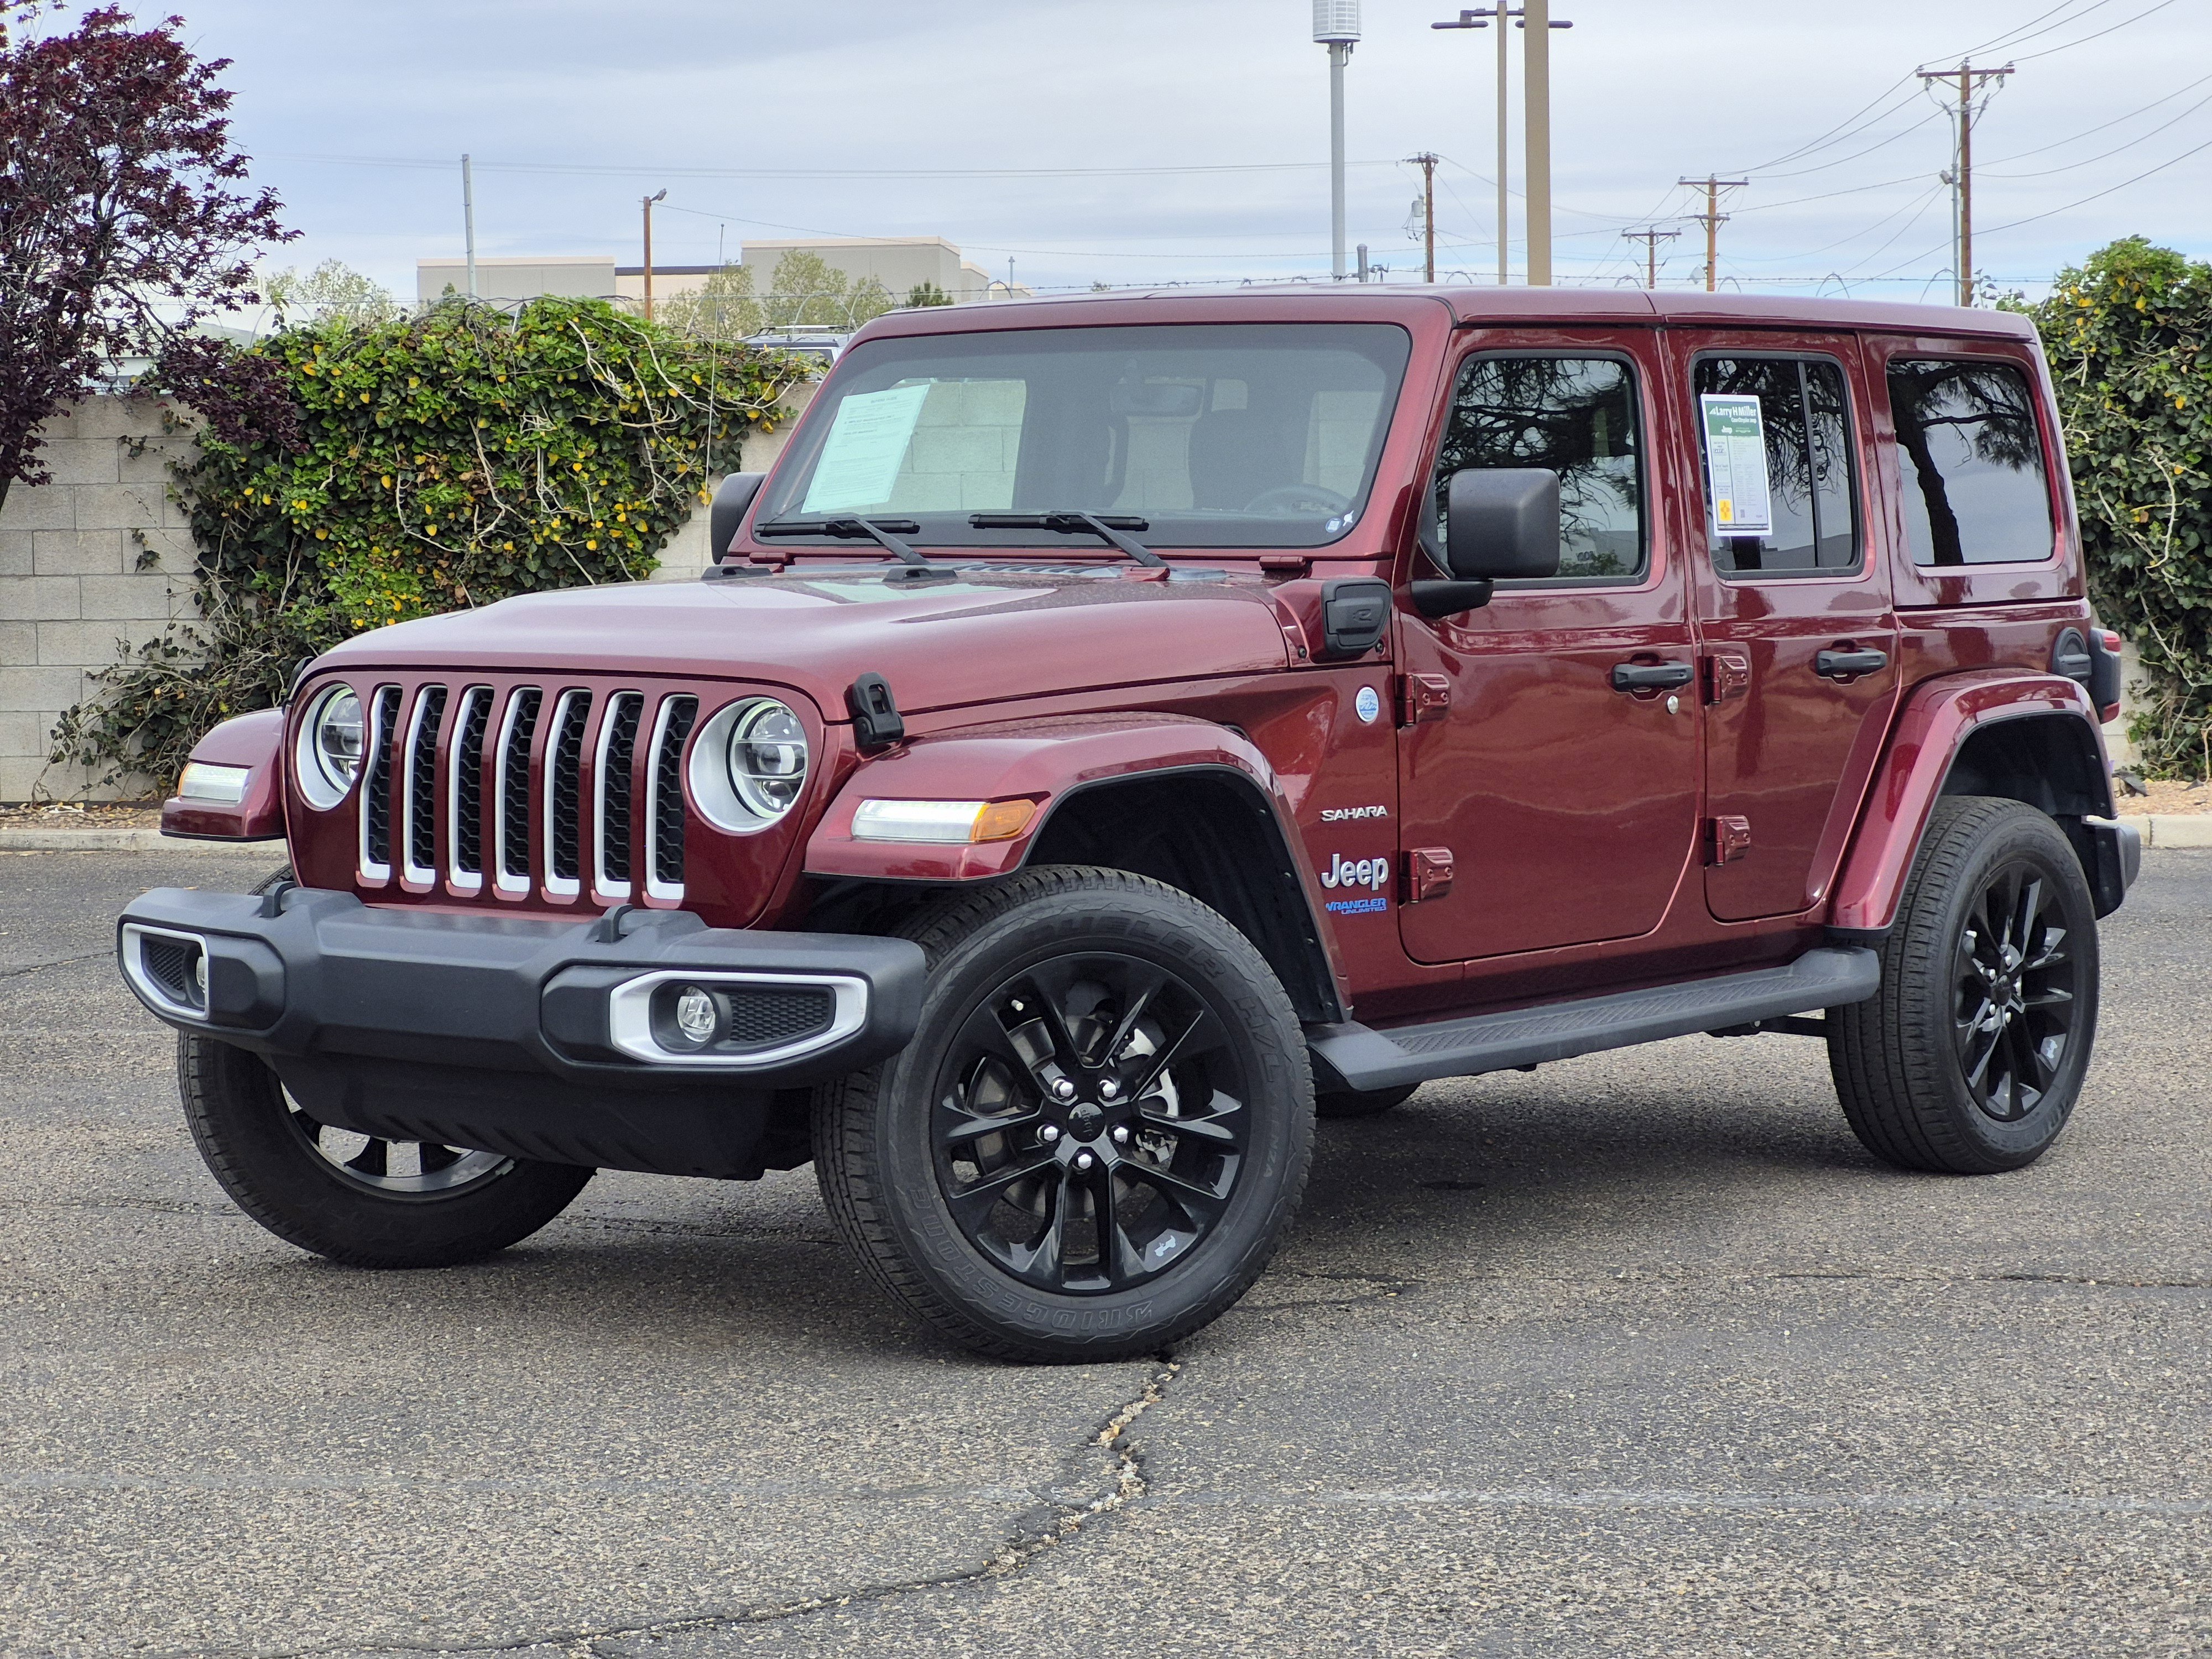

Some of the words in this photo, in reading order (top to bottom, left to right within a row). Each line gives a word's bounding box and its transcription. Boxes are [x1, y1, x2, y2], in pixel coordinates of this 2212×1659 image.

[1715, 405, 1732, 418] Larry
[1738, 405, 1756, 416] Miller
[1320, 805, 1388, 822] SAHARA
[1321, 853, 1389, 891] Jeep
[1325, 897, 1387, 912] WRANGLER
[1340, 905, 1387, 915] UNLIMITED
[1023, 916, 1226, 977] DUELER
[909, 1188, 1152, 1329] BRIDGESTONE
